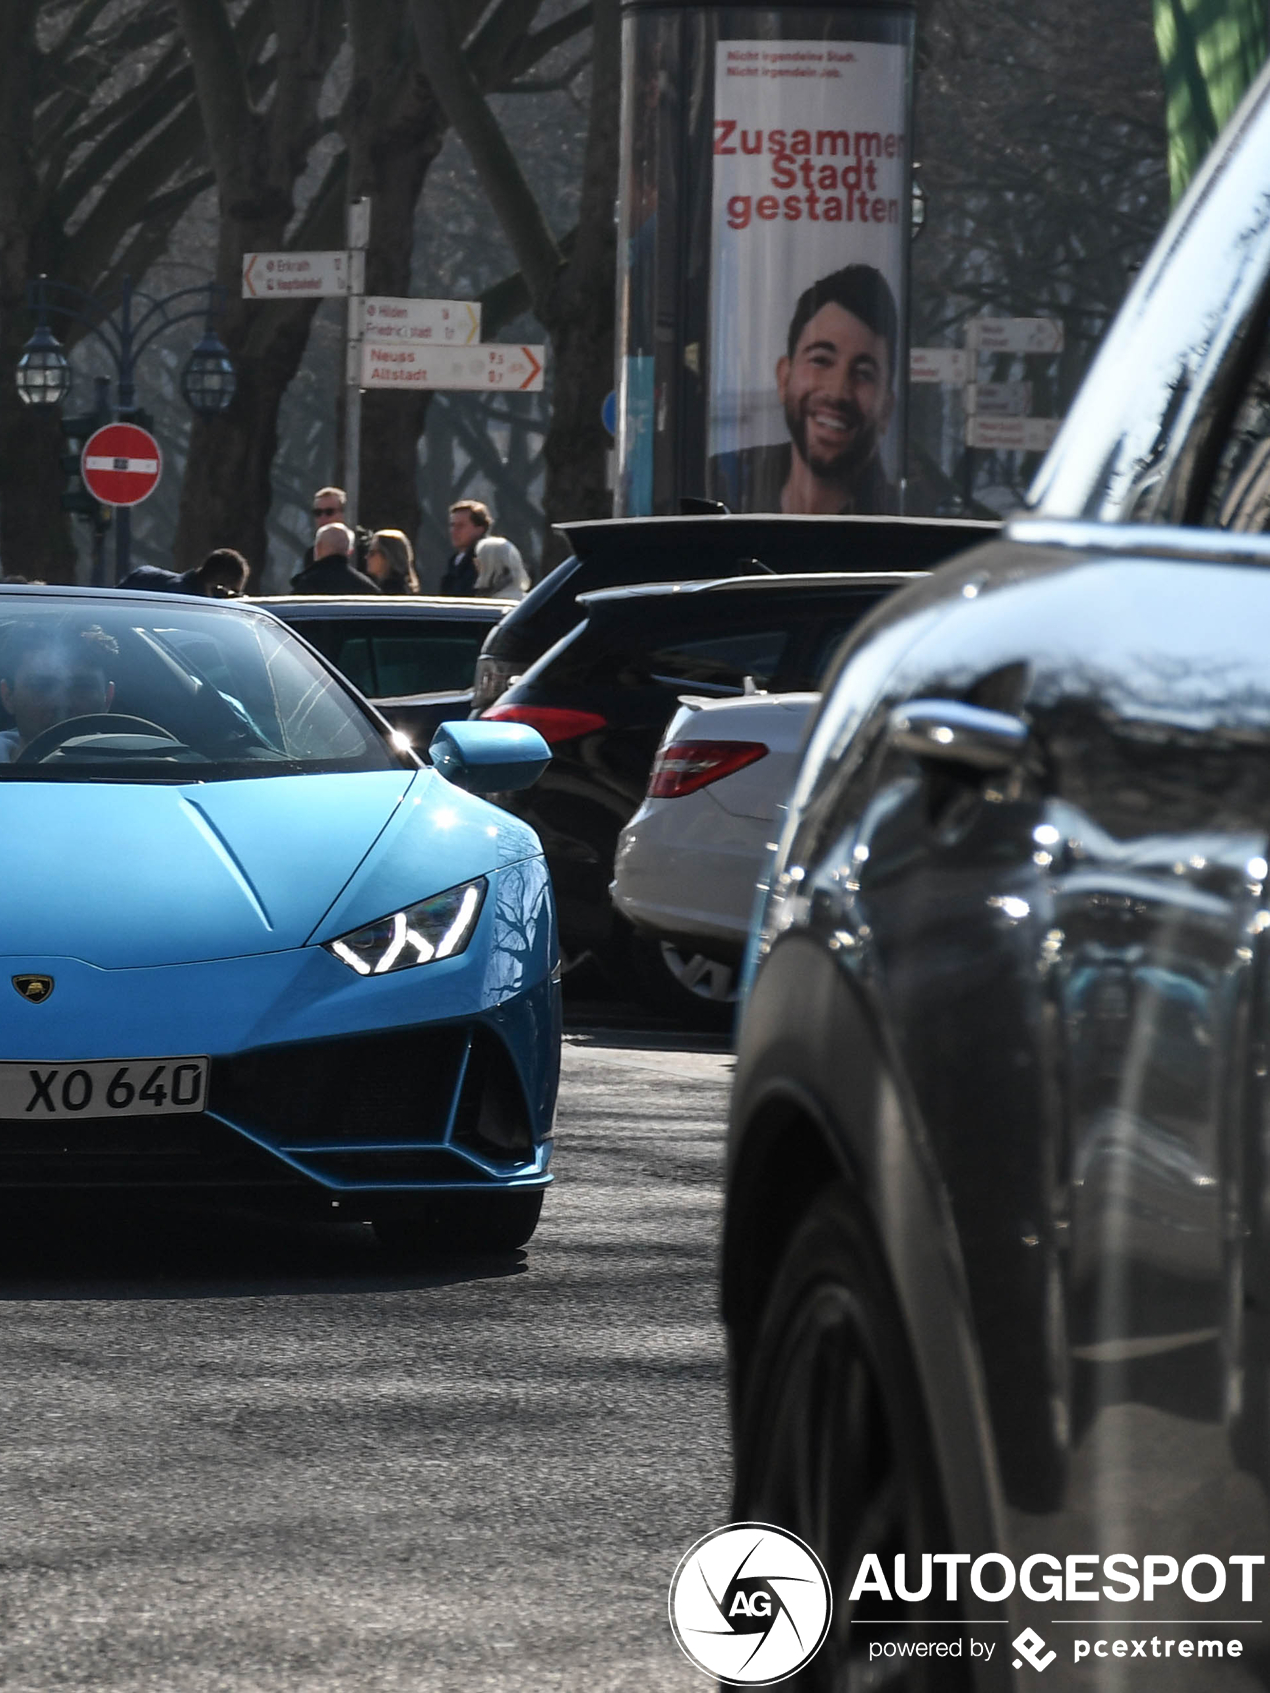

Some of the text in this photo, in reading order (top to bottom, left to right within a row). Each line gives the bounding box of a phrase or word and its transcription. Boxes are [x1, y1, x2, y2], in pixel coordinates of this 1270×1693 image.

[771, 152, 877, 191] Stadt
[726, 188, 899, 230] gestalten
[370, 348, 415, 363] Neuss
[371, 367, 428, 381] Altstadt
[25, 1069, 92, 1112] XO
[106, 1064, 201, 1108] 640
